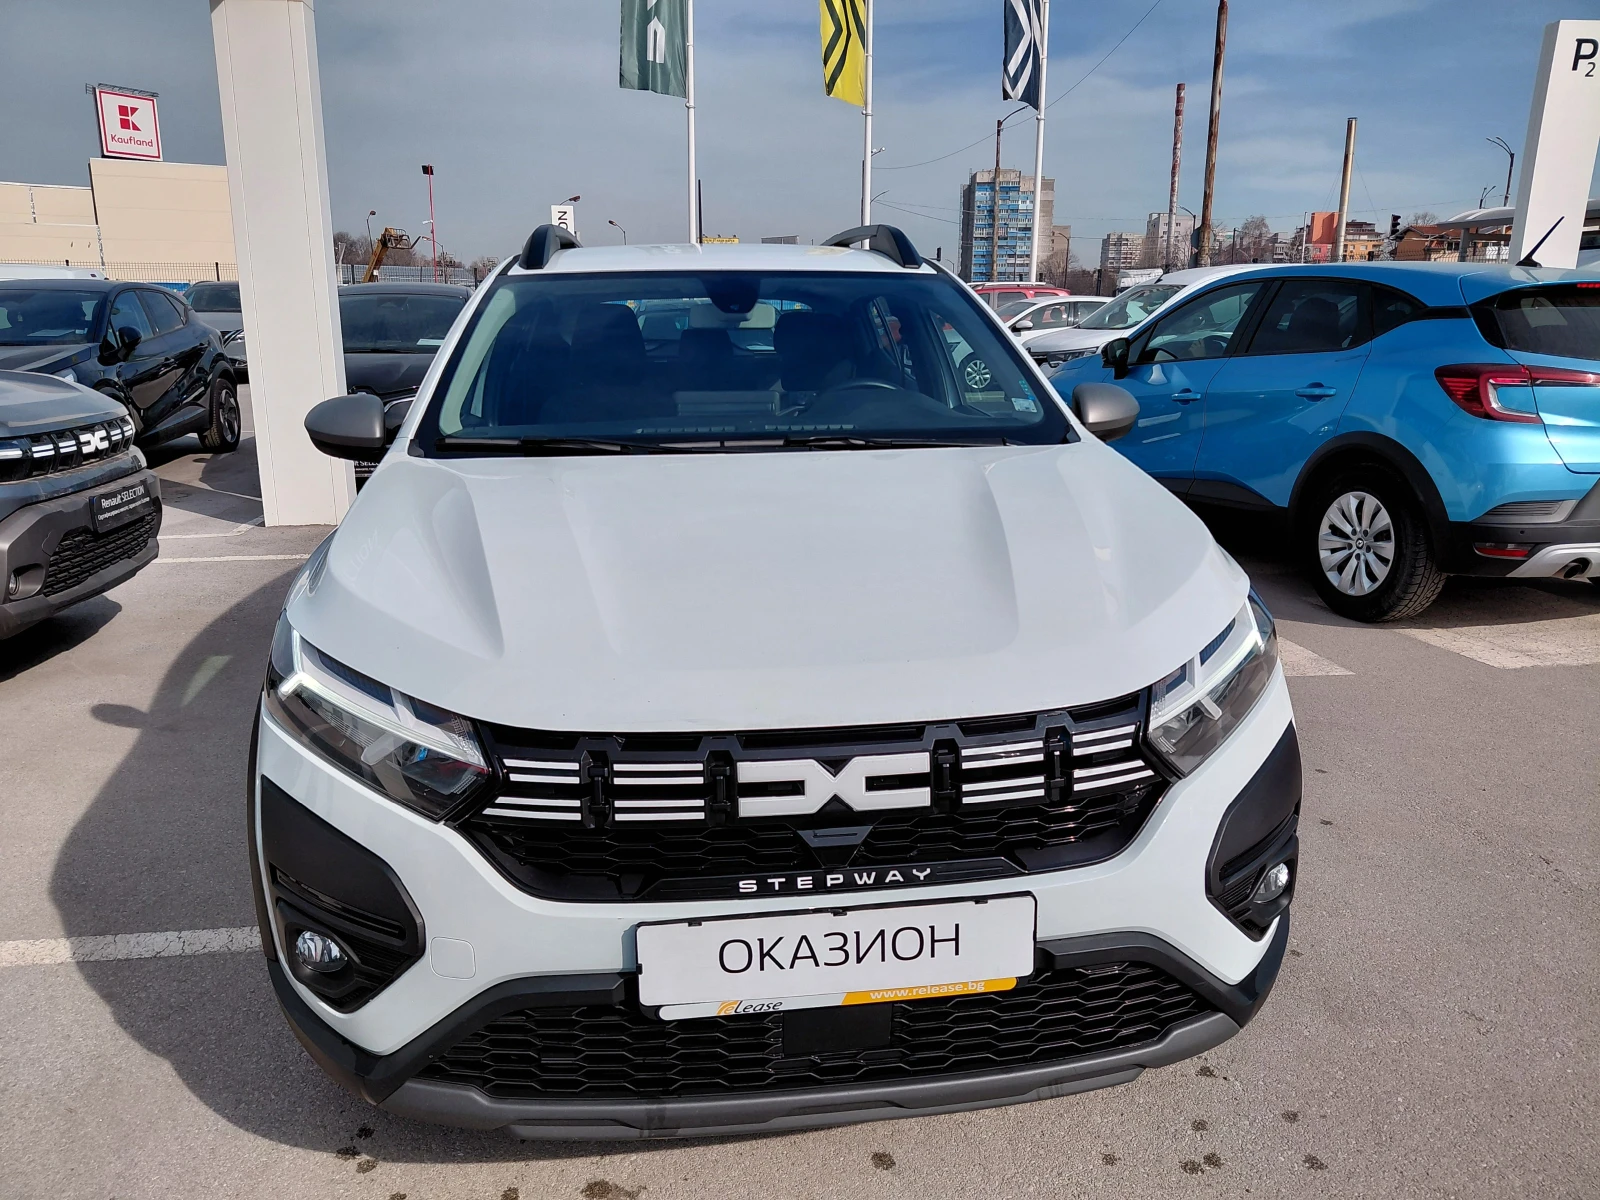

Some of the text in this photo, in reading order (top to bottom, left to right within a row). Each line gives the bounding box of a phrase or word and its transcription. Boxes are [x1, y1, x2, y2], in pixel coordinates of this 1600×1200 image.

[110, 133, 153, 147] Kaufland
[101, 494, 122, 509] Renault
[121, 485, 144, 502] SELECTION
[738, 867, 931, 893] STEPWAY
[718, 922, 960, 974] ОКАЗИОН
[869, 981, 985, 1000] www.release.bg
